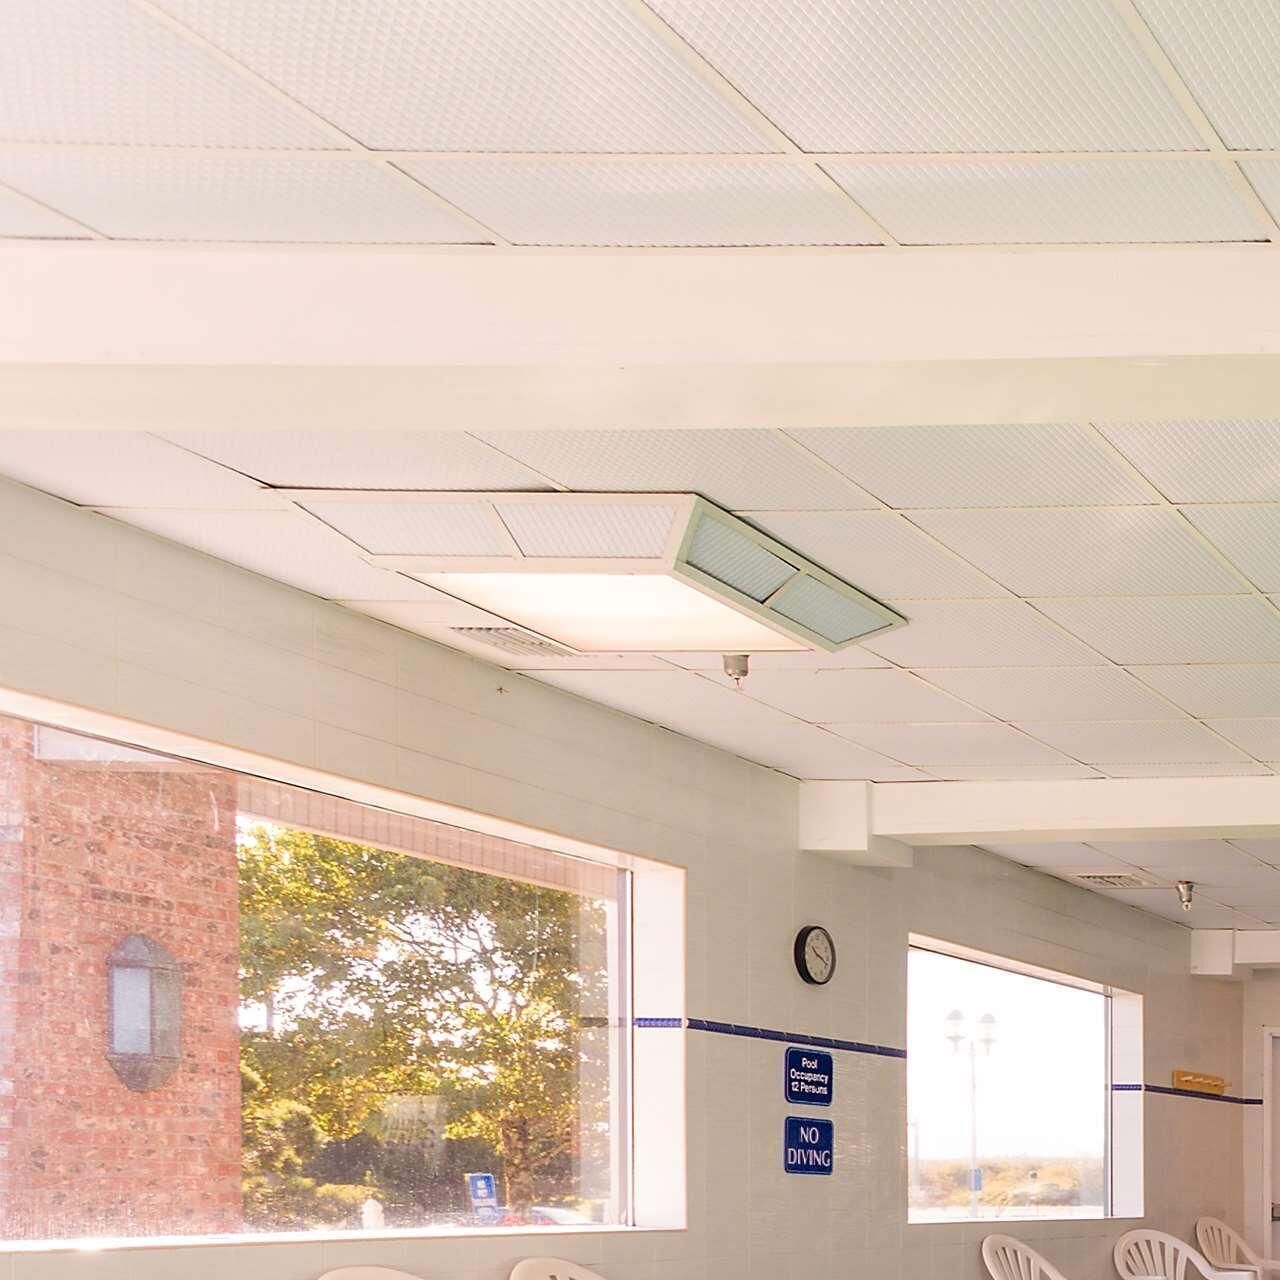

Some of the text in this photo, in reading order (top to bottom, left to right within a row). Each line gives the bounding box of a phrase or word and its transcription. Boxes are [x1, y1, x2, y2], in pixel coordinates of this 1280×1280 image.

[801, 1058, 818, 1069] Pool
[790, 1068, 829, 1084] Occupancy
[791, 1081, 828, 1095] 12 Persons
[800, 1127, 819, 1144] NO
[788, 1148, 831, 1167] DIVING
